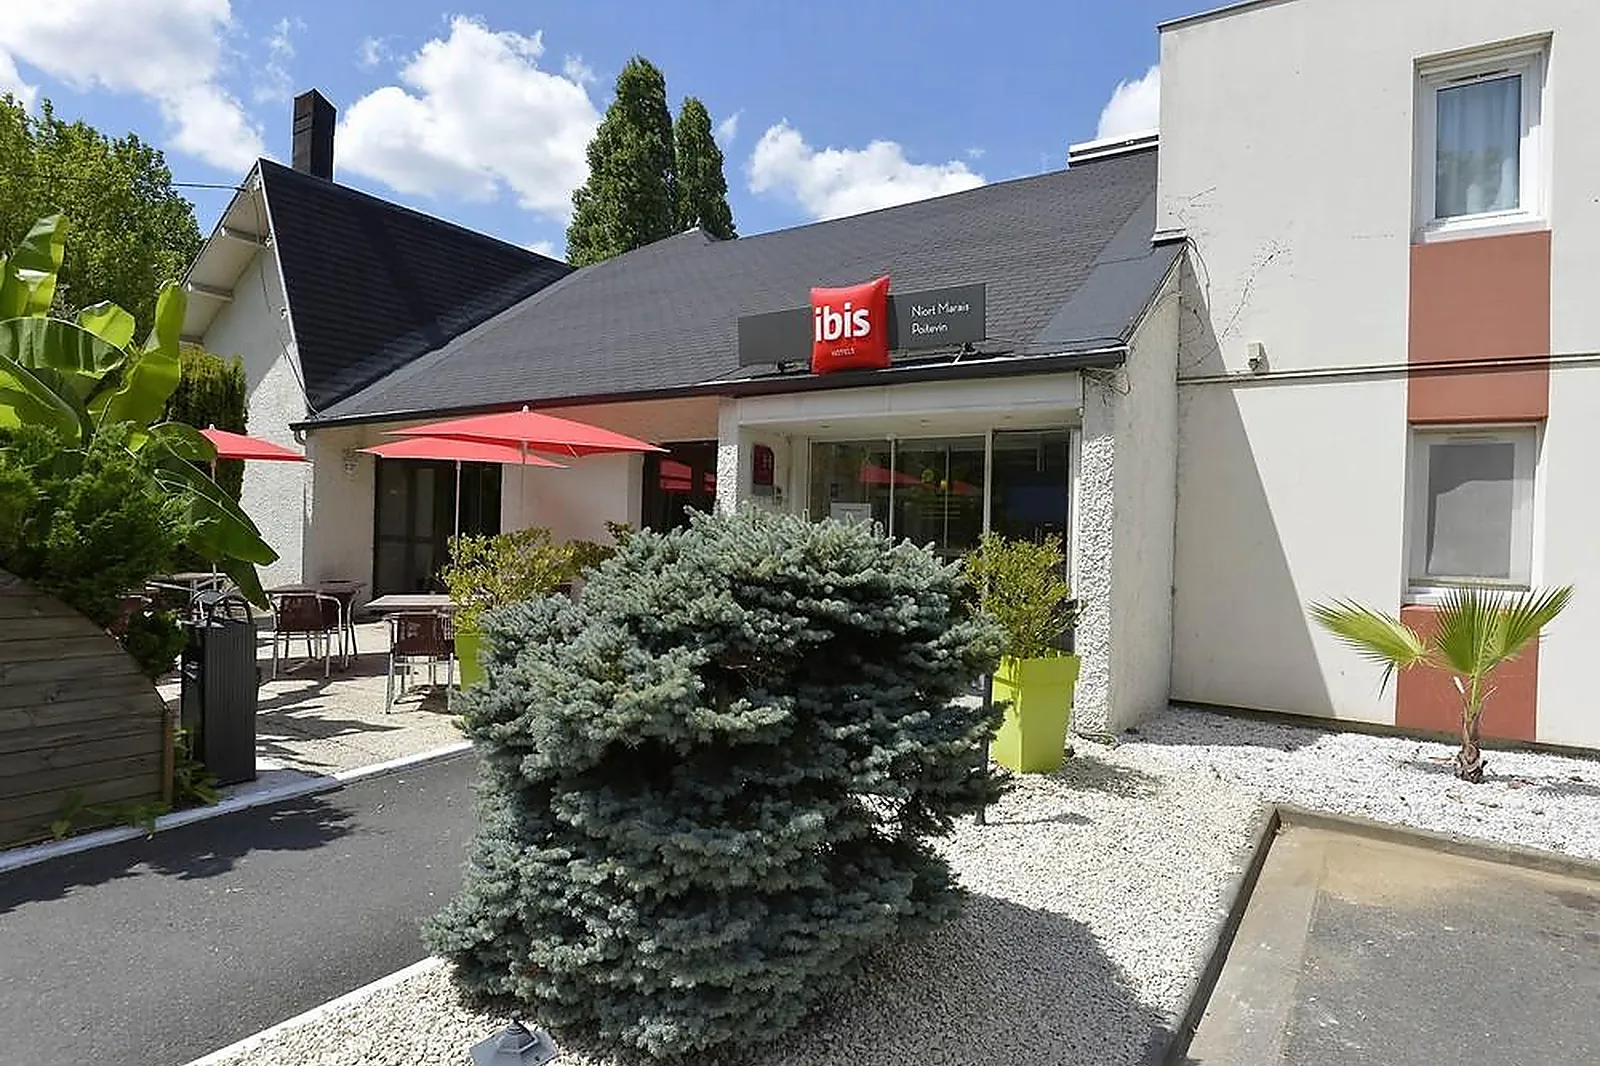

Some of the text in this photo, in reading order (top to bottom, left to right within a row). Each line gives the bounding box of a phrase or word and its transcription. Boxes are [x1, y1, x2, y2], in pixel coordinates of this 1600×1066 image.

[911, 304, 936, 317] Niort
[815, 302, 871, 342] ibis
[911, 322, 948, 335] Poitevin
